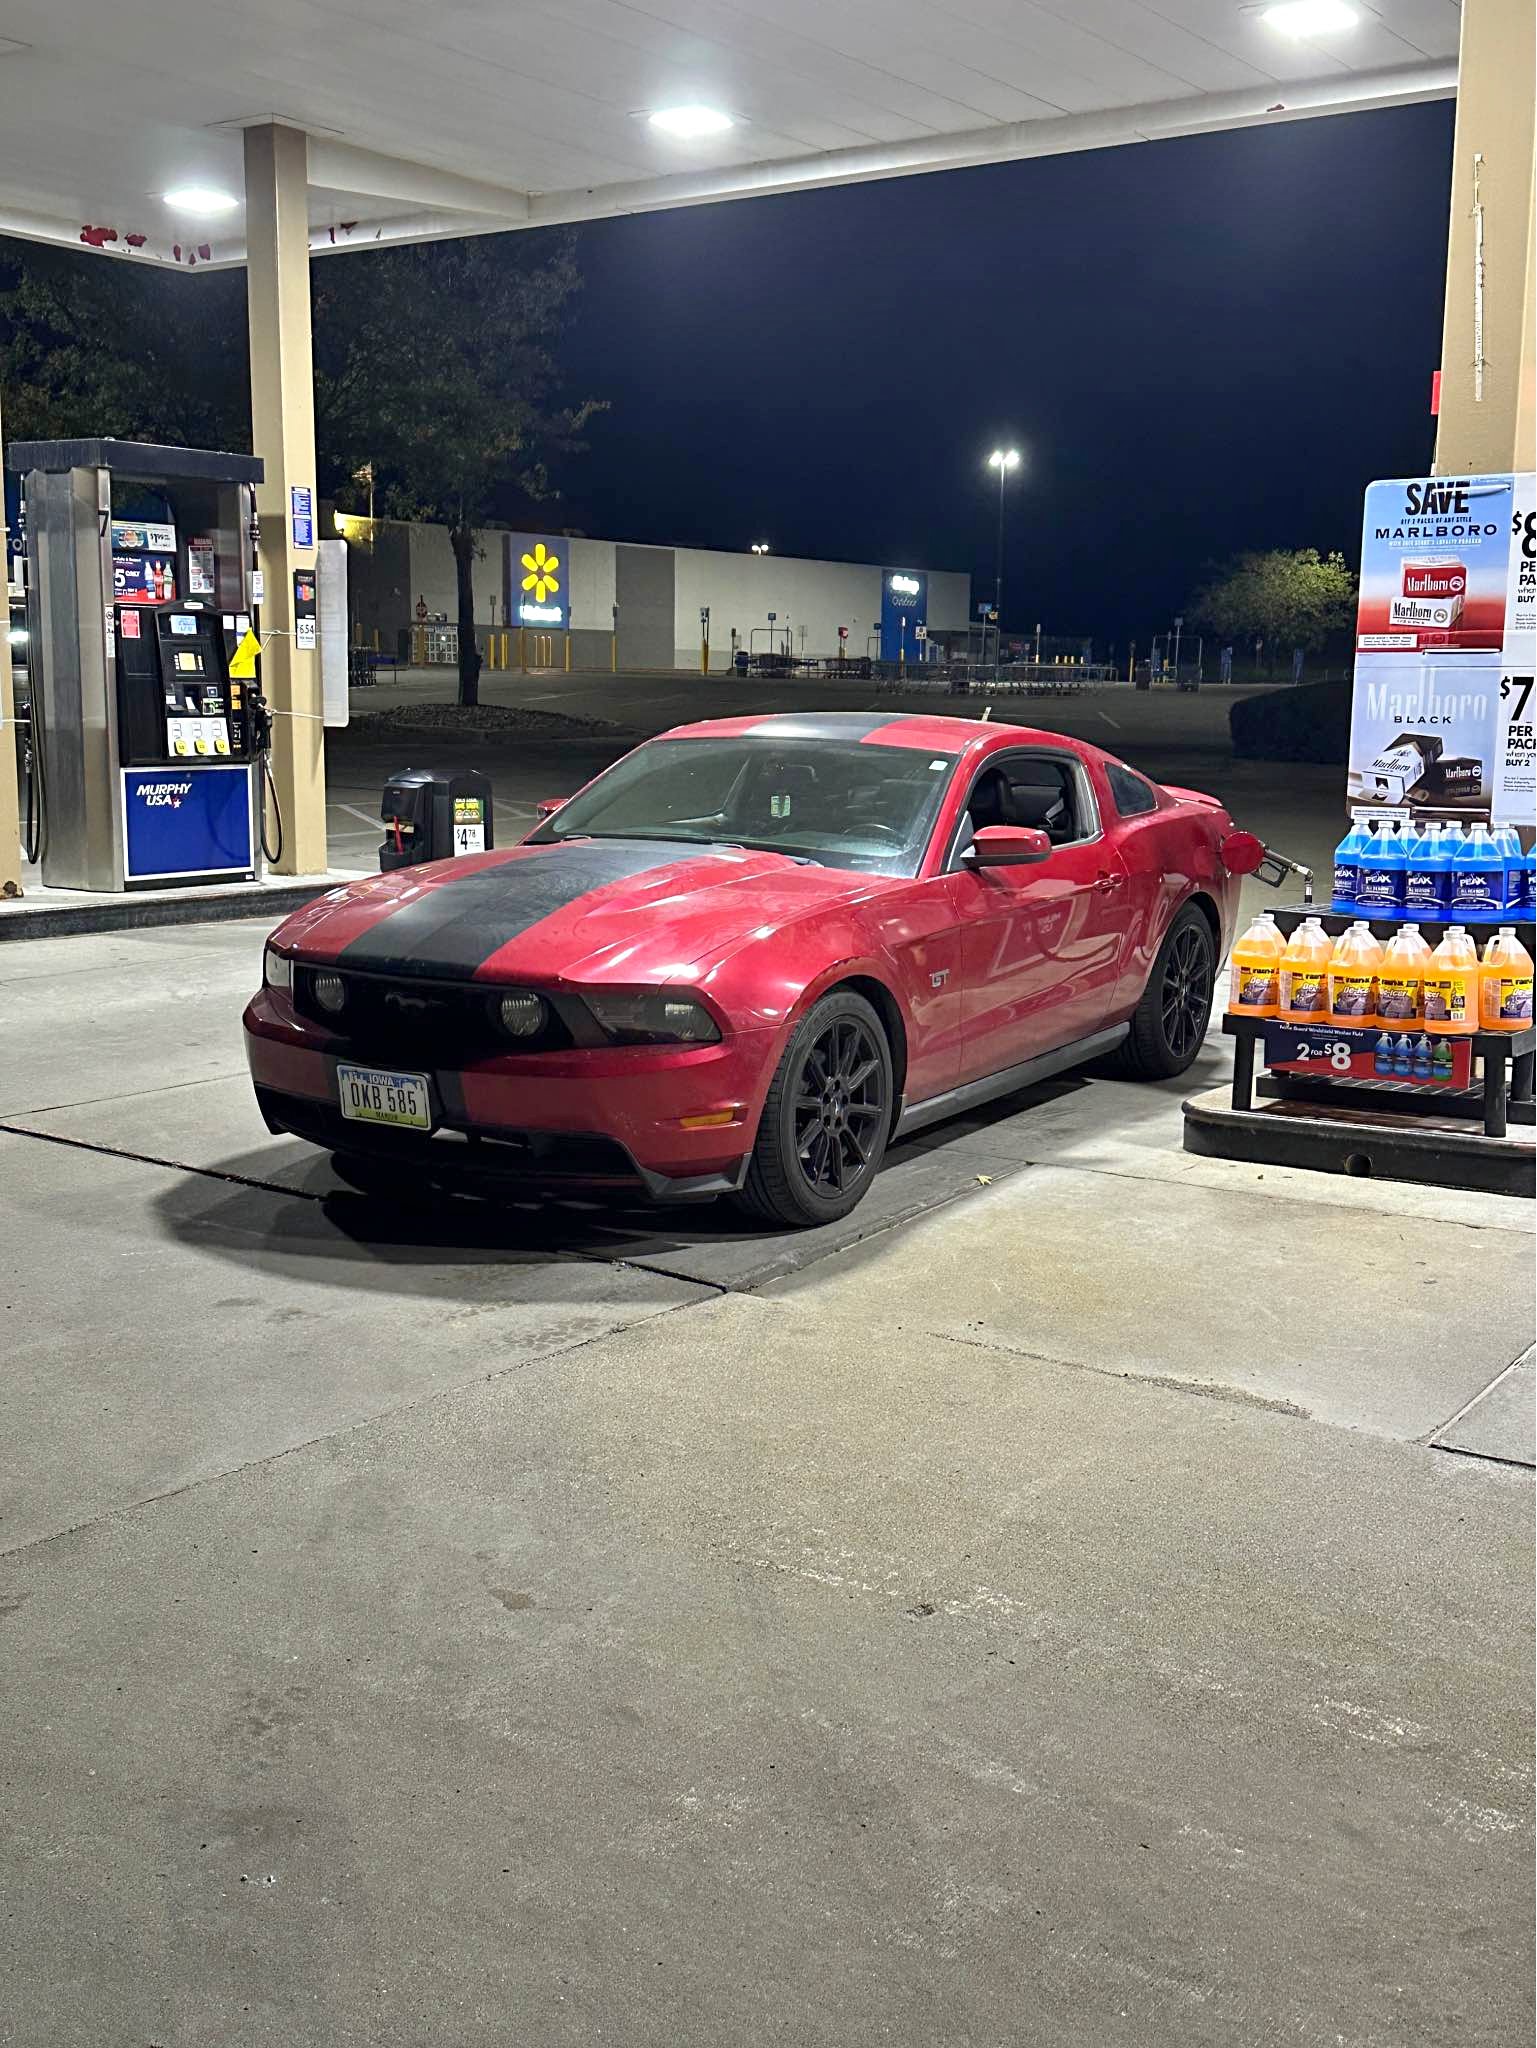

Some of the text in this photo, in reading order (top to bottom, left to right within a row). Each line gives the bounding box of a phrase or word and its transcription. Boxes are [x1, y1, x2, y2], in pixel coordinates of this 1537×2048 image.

[1405, 480, 1470, 515] SAVE
[98, 510, 109, 537] 7
[1375, 524, 1497, 539] MARLBORO
[1407, 574, 1448, 592] Marlboro
[1393, 601, 1432, 618] Marlboro
[1366, 665, 1488, 721] Marlboro
[1500, 676, 1534, 721] $7
[1394, 715, 1452, 724] BLACK
[1508, 726, 1533, 737] PER
[1372, 758, 1411, 772] Marlboro
[1505, 759, 1531, 767] BUY 2
[136, 783, 193, 796] MURPHY
[146, 795, 172, 806] USA
[1334, 869, 1354, 878] PEAK
[1365, 874, 1392, 884] PEAK
[1408, 876, 1433, 885] PEAK
[1460, 876, 1487, 887] PEAK
[932, 969, 950, 987] GT
[1296, 1042, 1310, 1061] 2
[1324, 1042, 1351, 1070] $8
[368, 1074, 394, 1086] IOWA
[387, 1087, 417, 1116] 585
